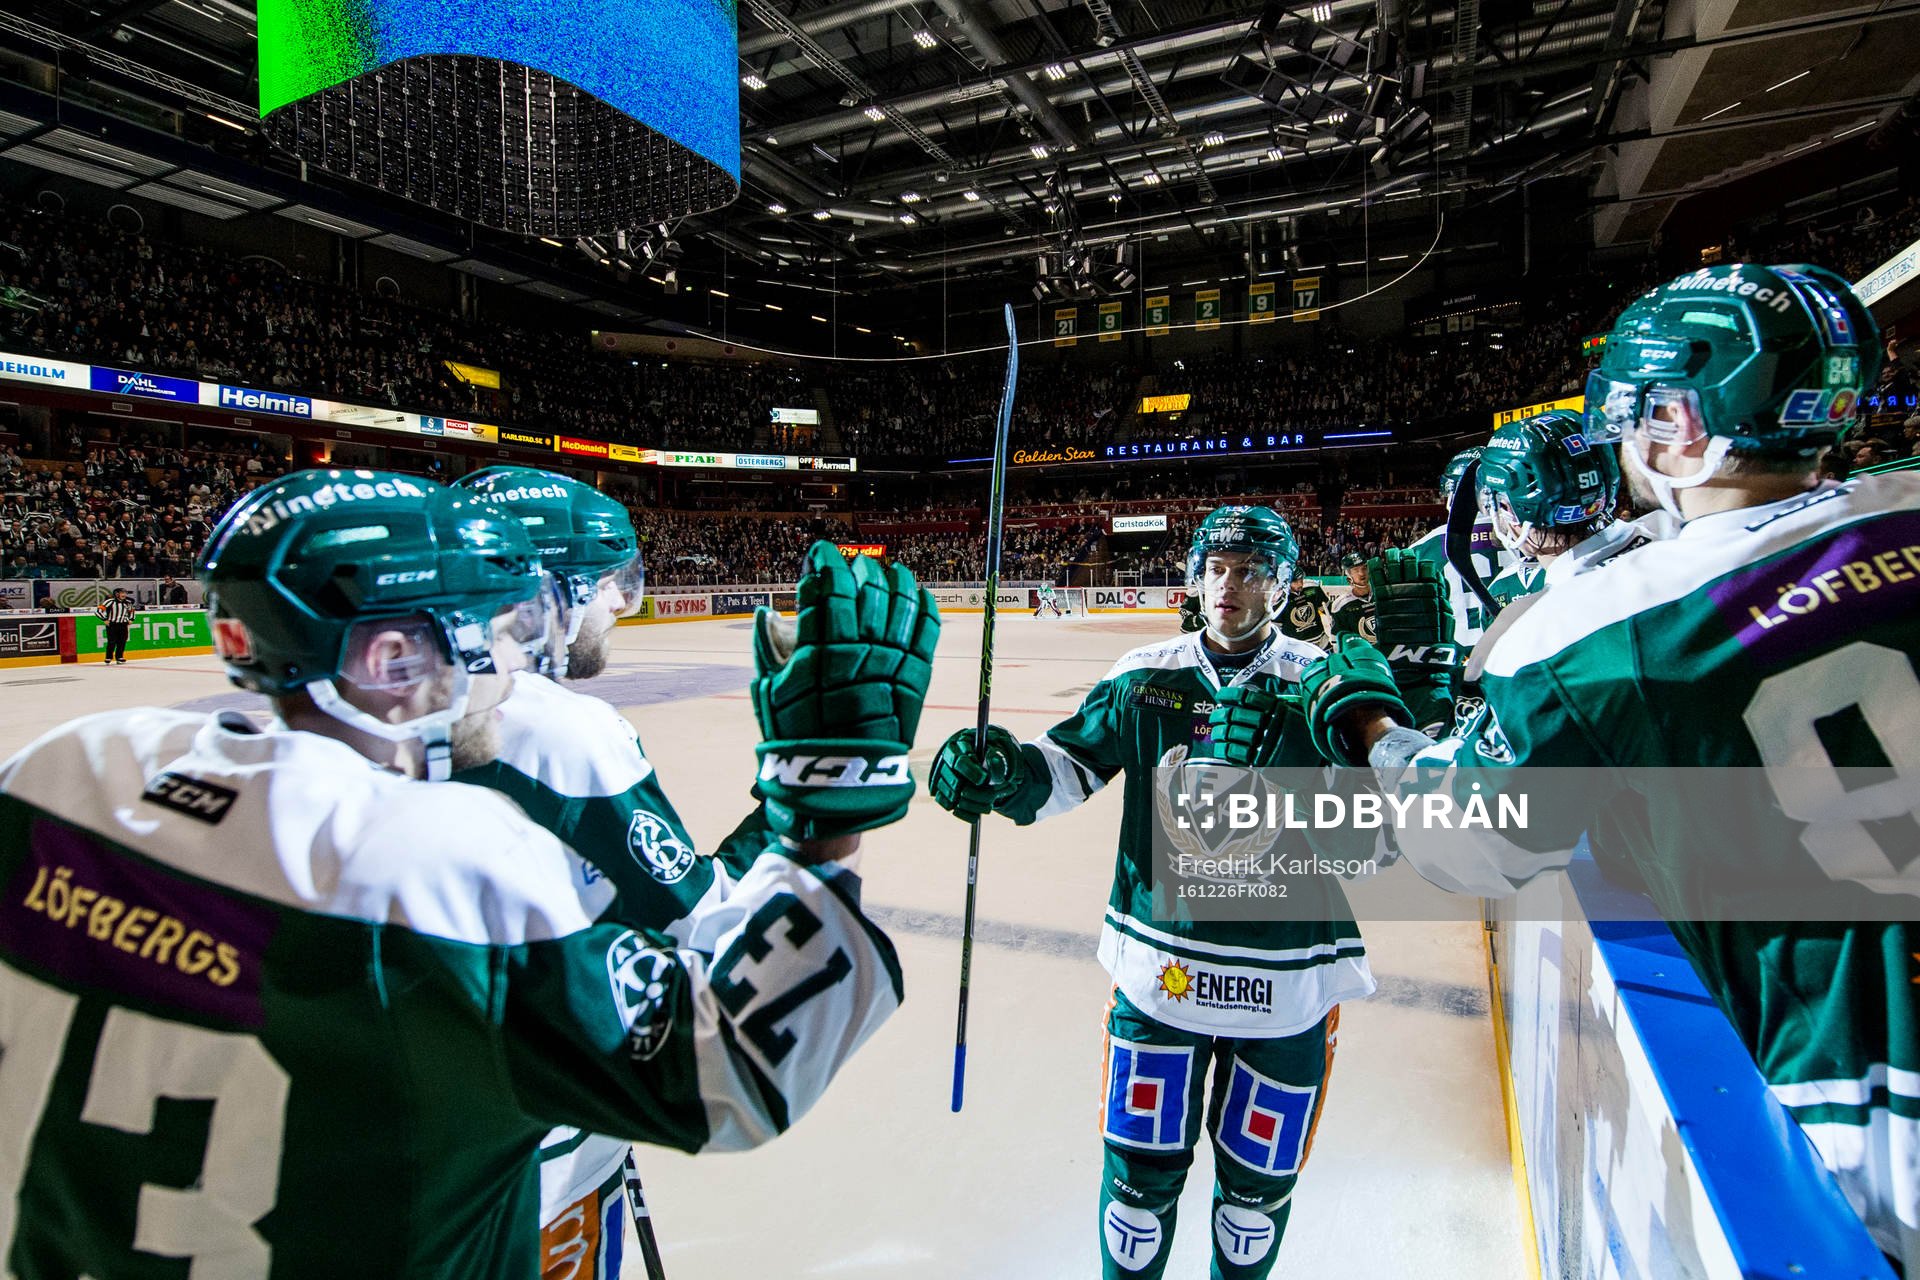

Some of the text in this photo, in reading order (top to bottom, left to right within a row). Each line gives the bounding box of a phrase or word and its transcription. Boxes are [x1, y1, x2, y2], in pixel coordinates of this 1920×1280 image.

[1256, 295, 1268, 311] 9
[1297, 291, 1315, 308] 17
[1152, 309, 1164, 323] 5
[1202, 302, 1213, 318] 2
[1058, 320, 1074, 334] 21
[1105, 314, 1116, 329] 9
[118, 375, 157, 388] DAHL
[222, 387, 309, 415] Helmia
[447, 421, 468, 429] RICOH
[561, 439, 607, 454] McDonald's
[1107, 434, 1304, 455] RESTAURANG & BAR
[675, 455, 716, 464] PEAB
[1013, 447, 1096, 465] Golden Star
[1578, 470, 1600, 489] 50
[656, 599, 707, 614] Vi SYNS
[1095, 590, 1146, 608] DALOC
[1145, 695, 1175, 709] HUSET
[24, 866, 241, 987] LÖFBERGS
[1196, 971, 1273, 1006] ENERGI
[1195, 999, 1273, 1015] karlstadsenergi.se
